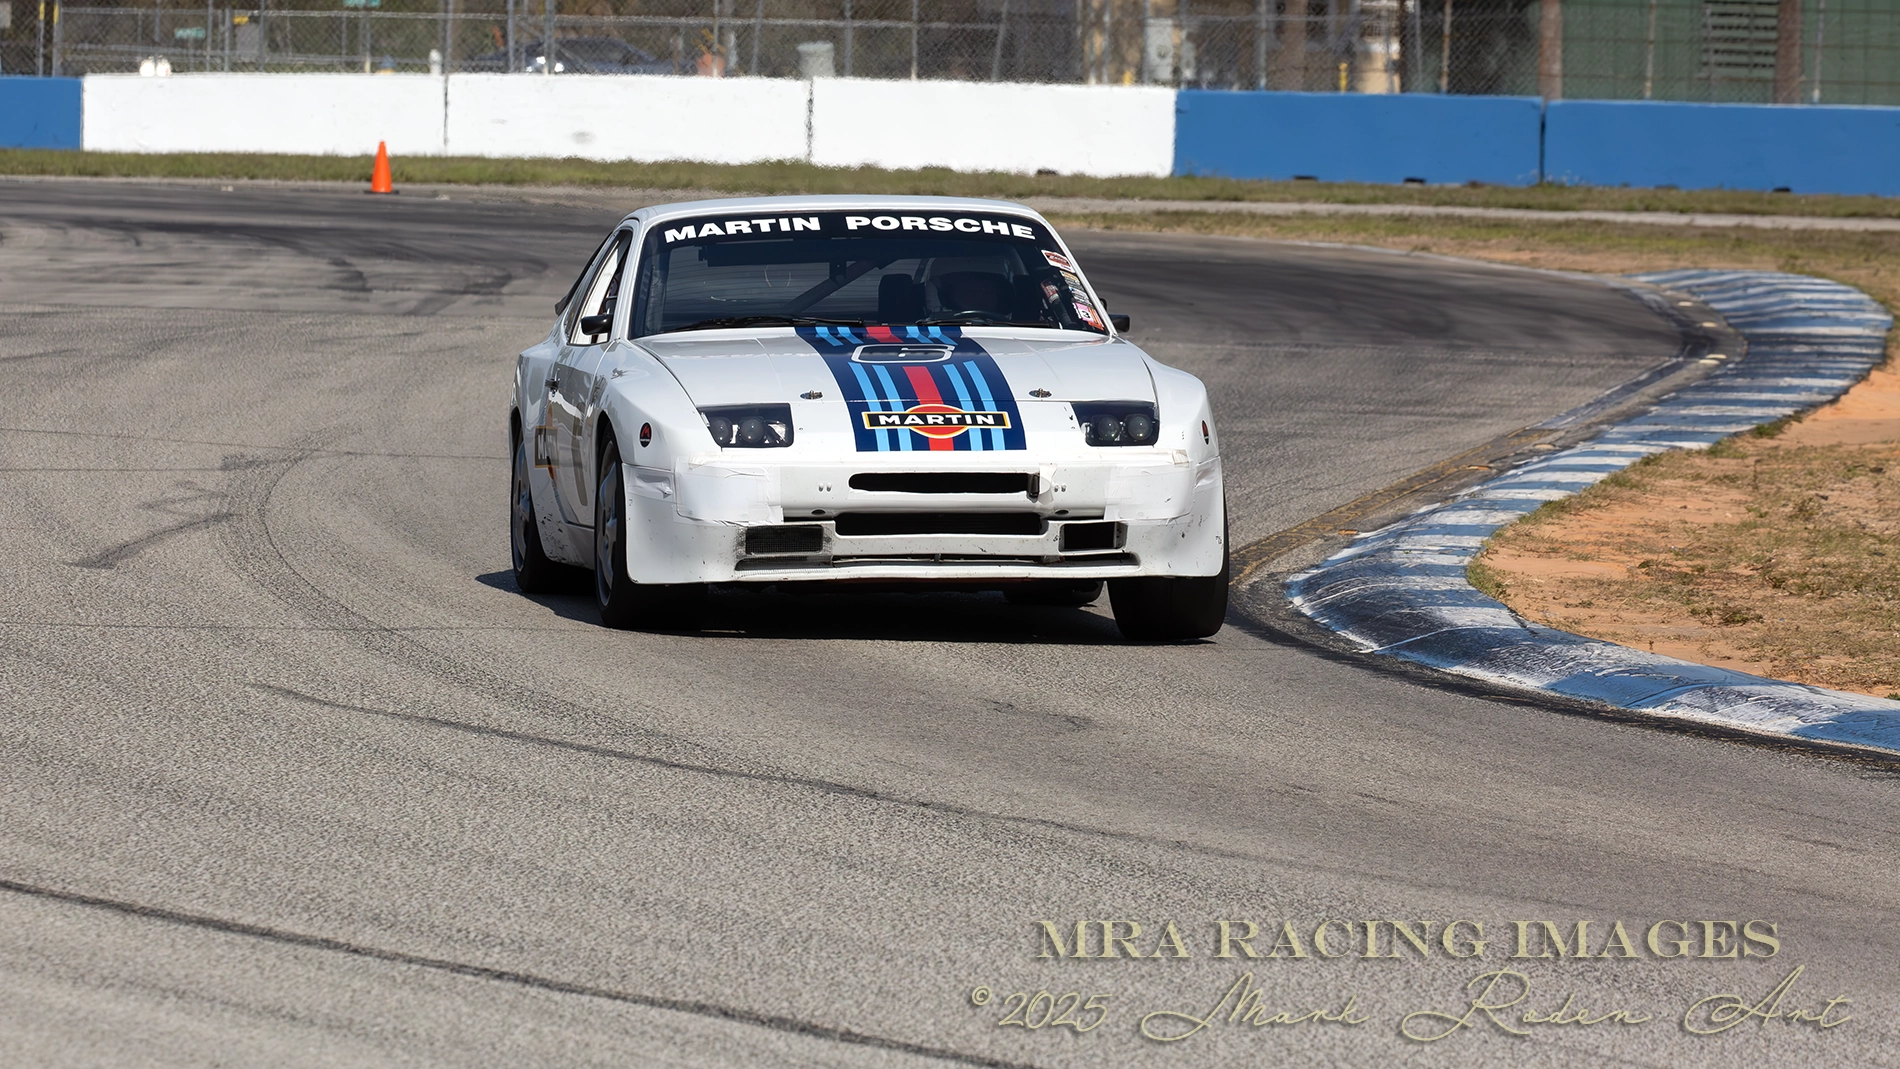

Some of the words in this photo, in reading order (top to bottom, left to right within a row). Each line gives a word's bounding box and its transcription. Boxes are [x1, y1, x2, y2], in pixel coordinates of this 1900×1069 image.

[664, 217, 821, 243] MARTIN
[845, 216, 1036, 240] PORSCHE
[878, 414, 995, 425] MARTIN
